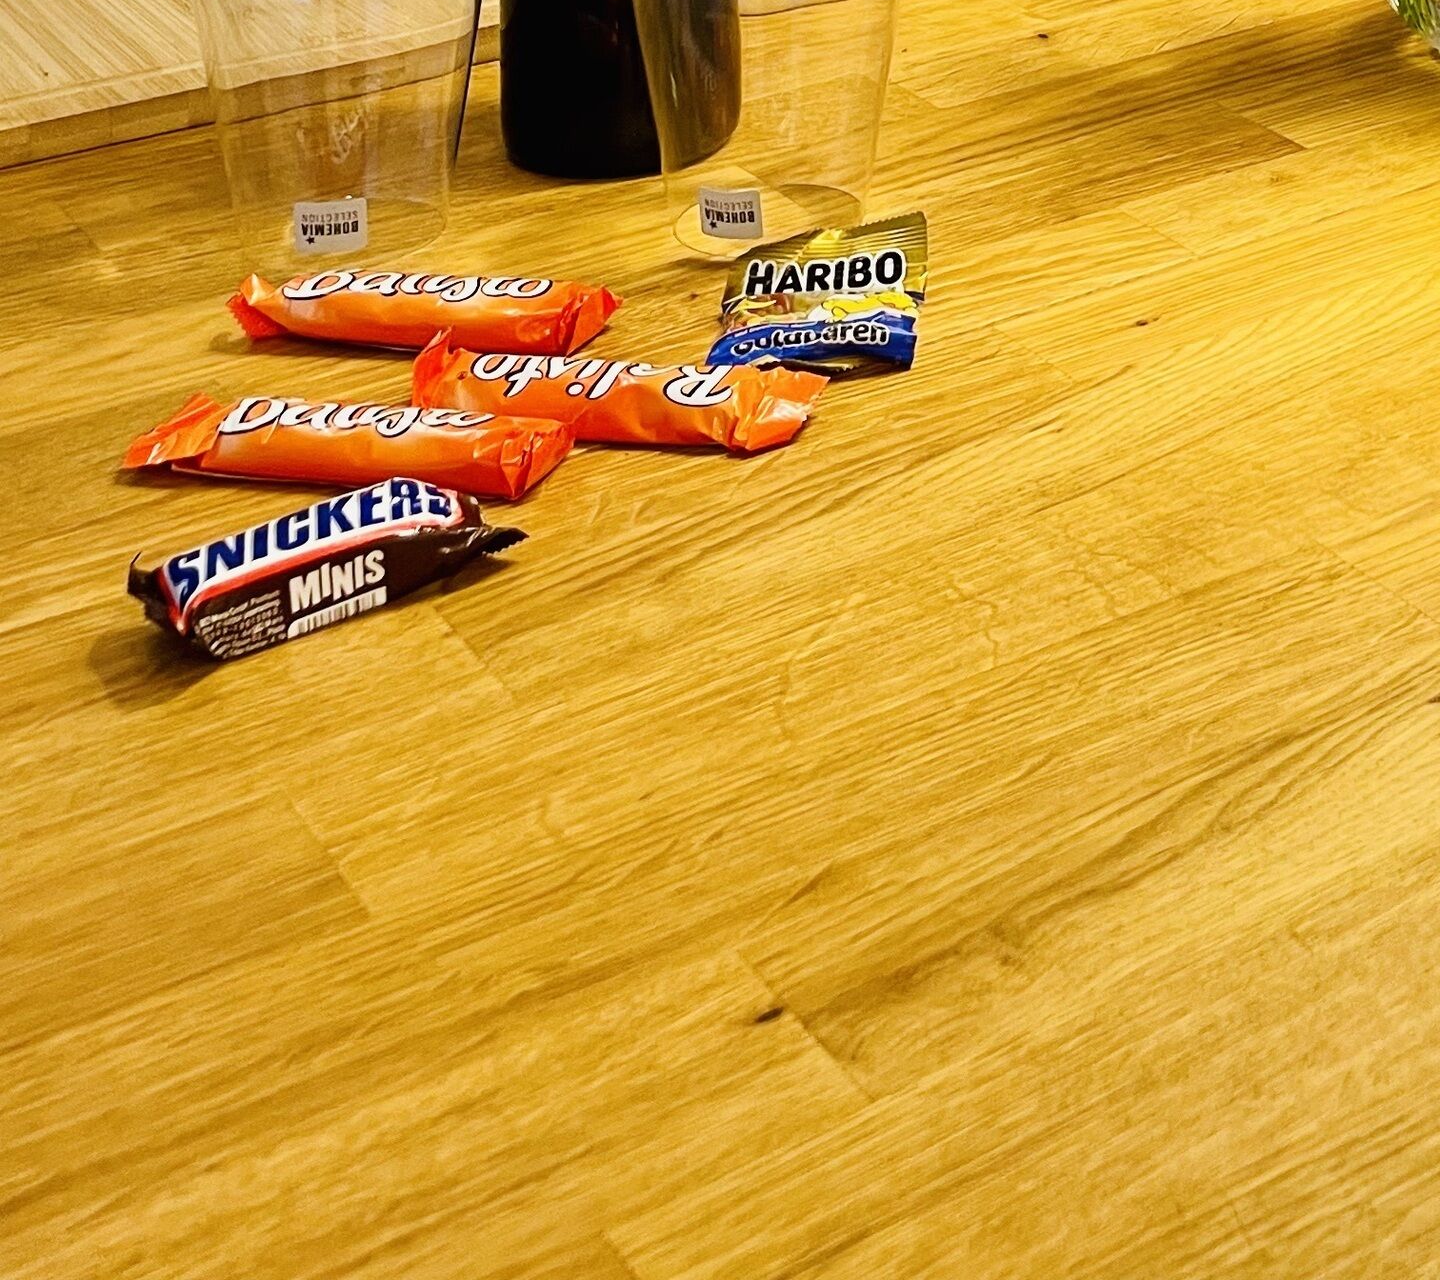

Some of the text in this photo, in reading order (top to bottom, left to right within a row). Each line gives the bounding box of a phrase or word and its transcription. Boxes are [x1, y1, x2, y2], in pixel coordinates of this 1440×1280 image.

[301, 220, 359, 236] BOHEMIA
[302, 210, 359, 223] SELECTION
[704, 207, 755, 223] BOHEMIA
[745, 250, 904, 297] HARIBO
[168, 479, 452, 608] SNICKERS
[288, 549, 386, 614] MINIS
